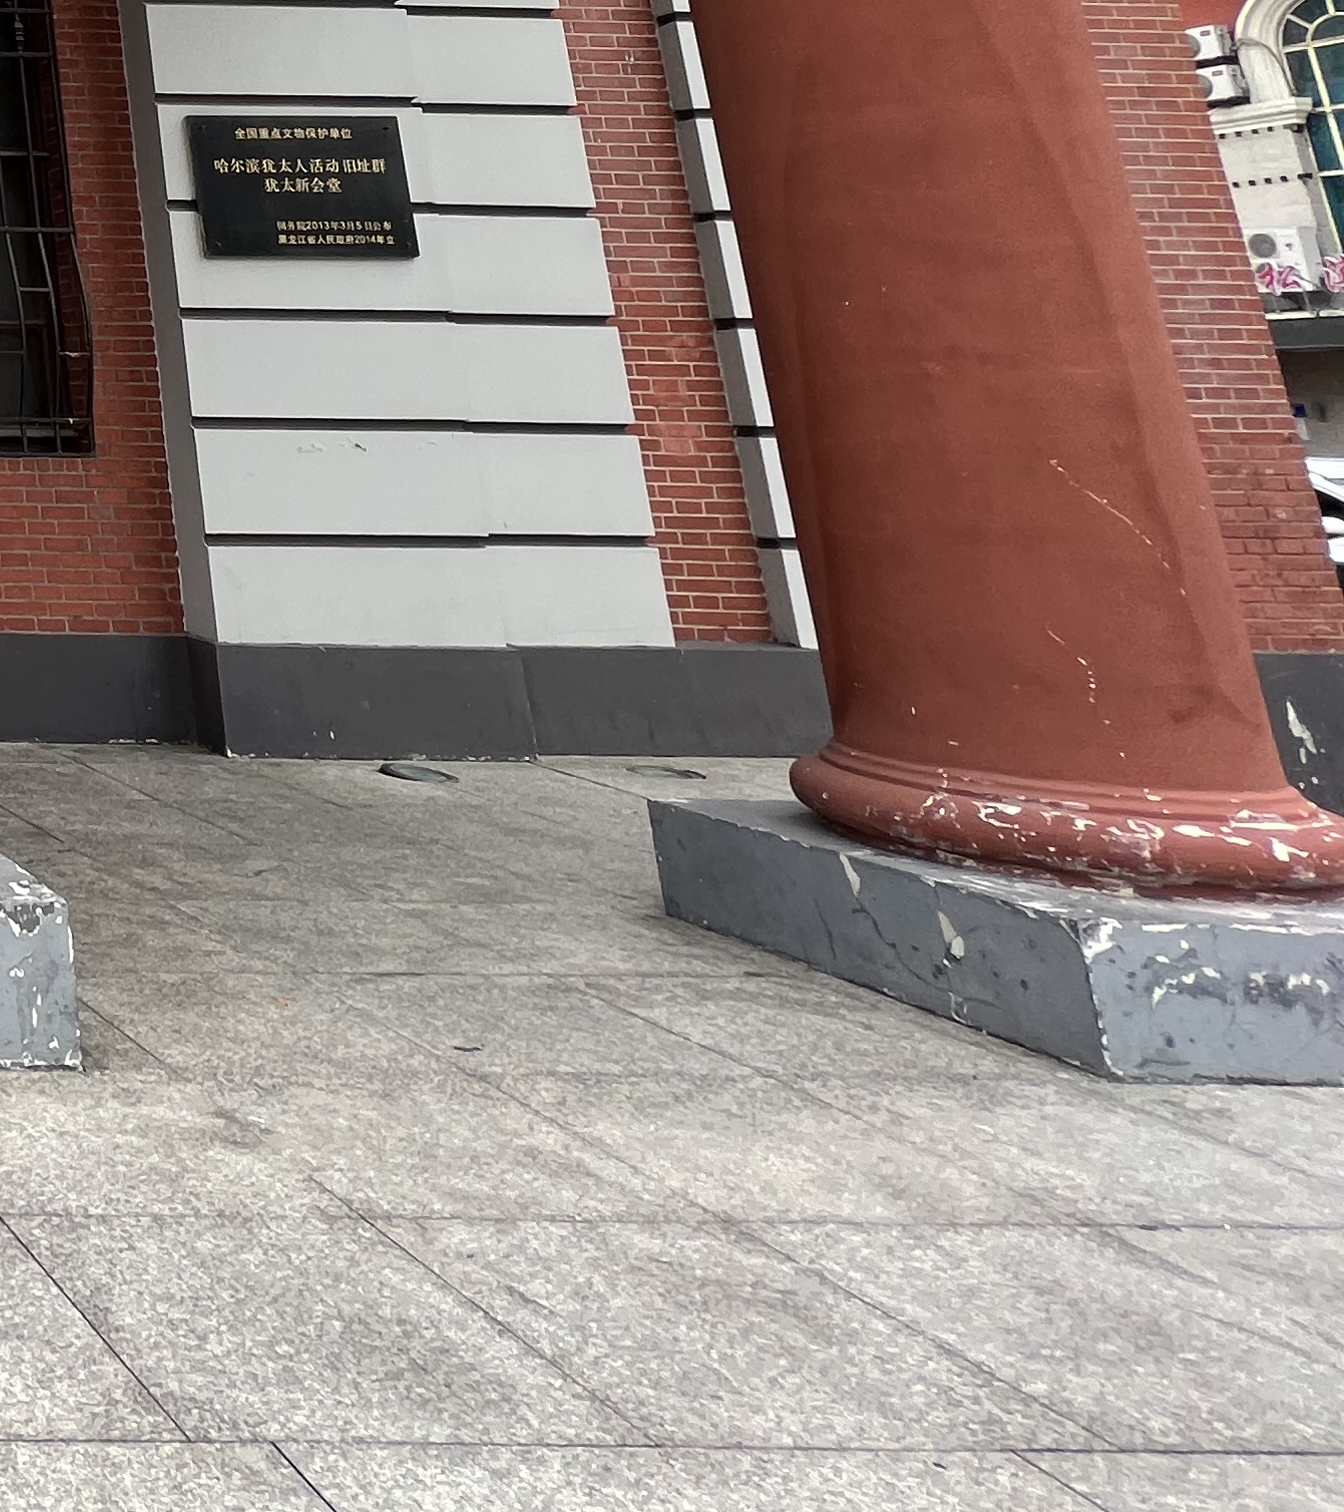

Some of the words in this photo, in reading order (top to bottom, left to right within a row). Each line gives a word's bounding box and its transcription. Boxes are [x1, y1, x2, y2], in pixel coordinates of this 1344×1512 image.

[234, 127, 353, 140] 全国重点文物保护单位
[213, 157, 388, 175] 哈尔滨犹太人活动旧址群
[264, 176, 343, 193] 犹太新会堂
